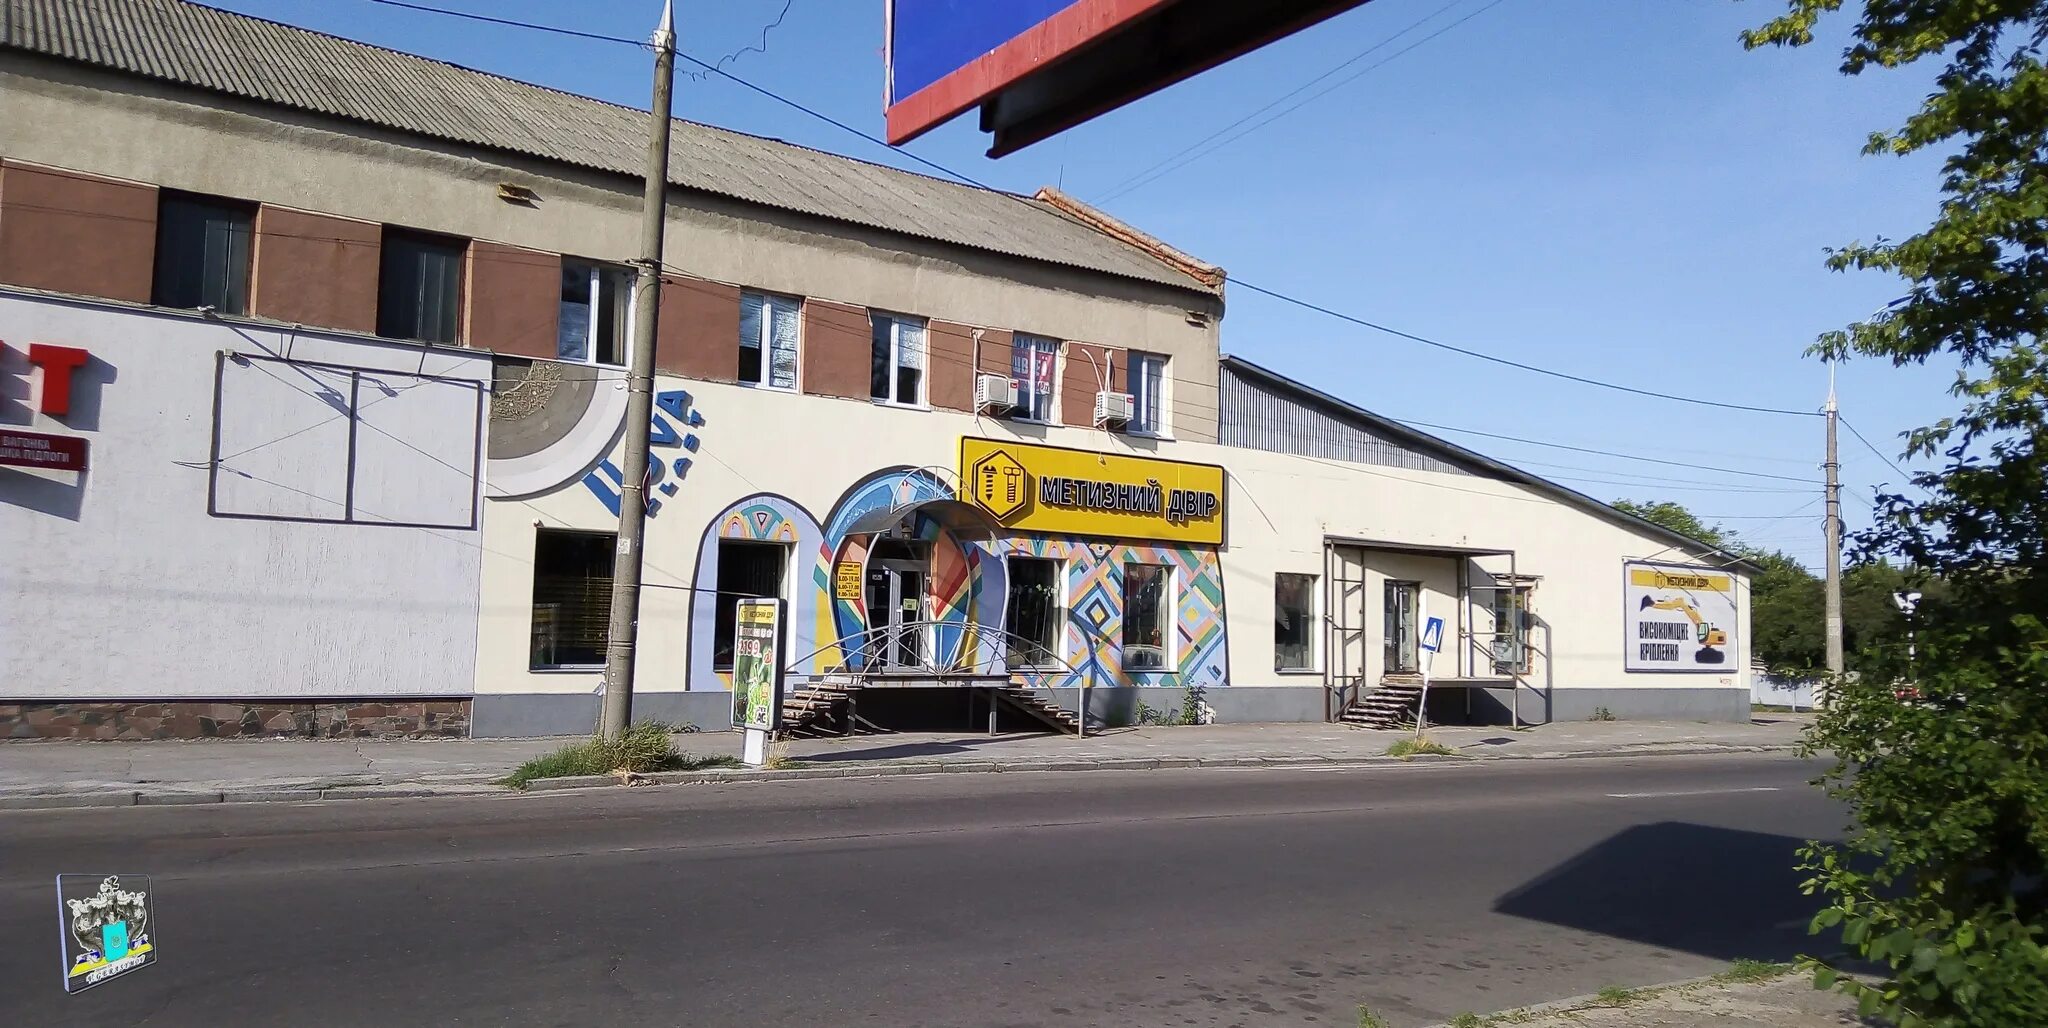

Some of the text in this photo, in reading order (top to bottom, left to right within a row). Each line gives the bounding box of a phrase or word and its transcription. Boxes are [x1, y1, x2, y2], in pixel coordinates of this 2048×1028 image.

[1040, 475, 1217, 522] МЕТИЗНИЙ ДВІР
[1640, 643, 1679, 661] КРІПЛЕННЯ
